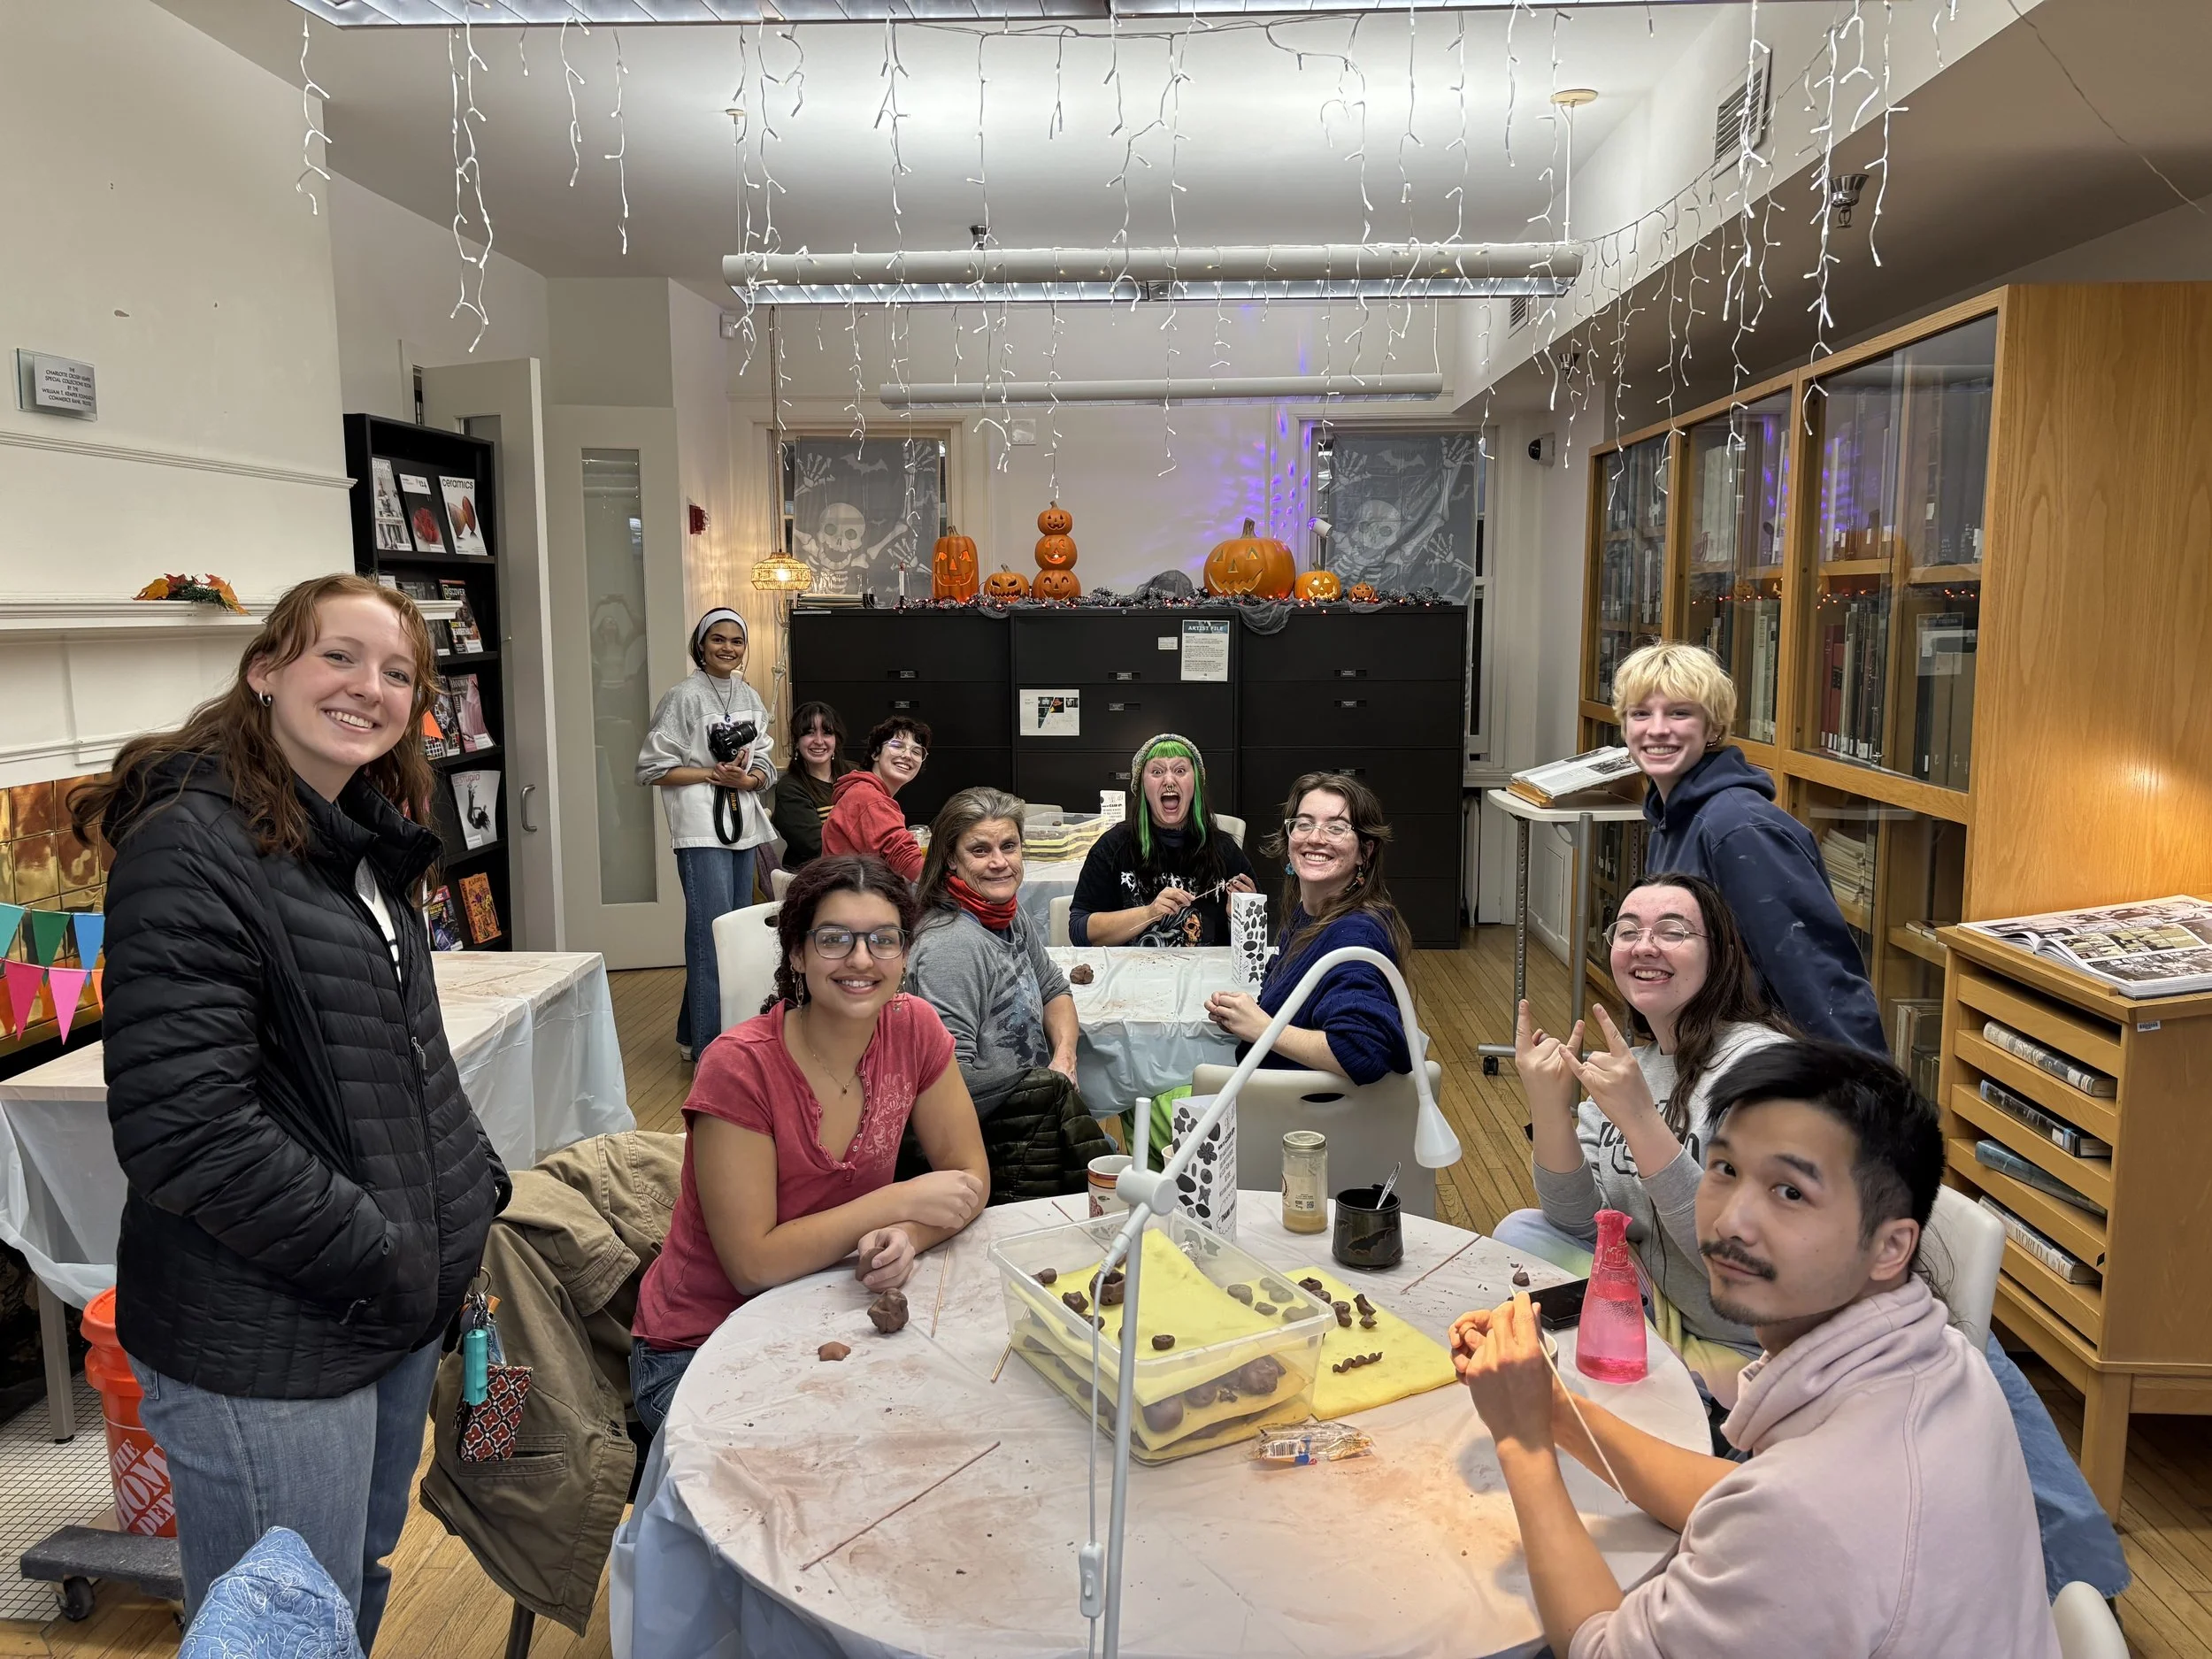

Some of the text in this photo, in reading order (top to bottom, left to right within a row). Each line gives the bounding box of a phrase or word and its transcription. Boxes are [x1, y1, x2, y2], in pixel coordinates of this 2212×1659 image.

[442, 478, 473, 489] ceramics
[729, 792, 738, 811] Nikon
[1221, 1208, 1230, 1223] THANK
[2015, 1226, 2043, 1259] WORLD
[111, 1438, 142, 1479] THE
[115, 1442, 171, 1530] HOM
